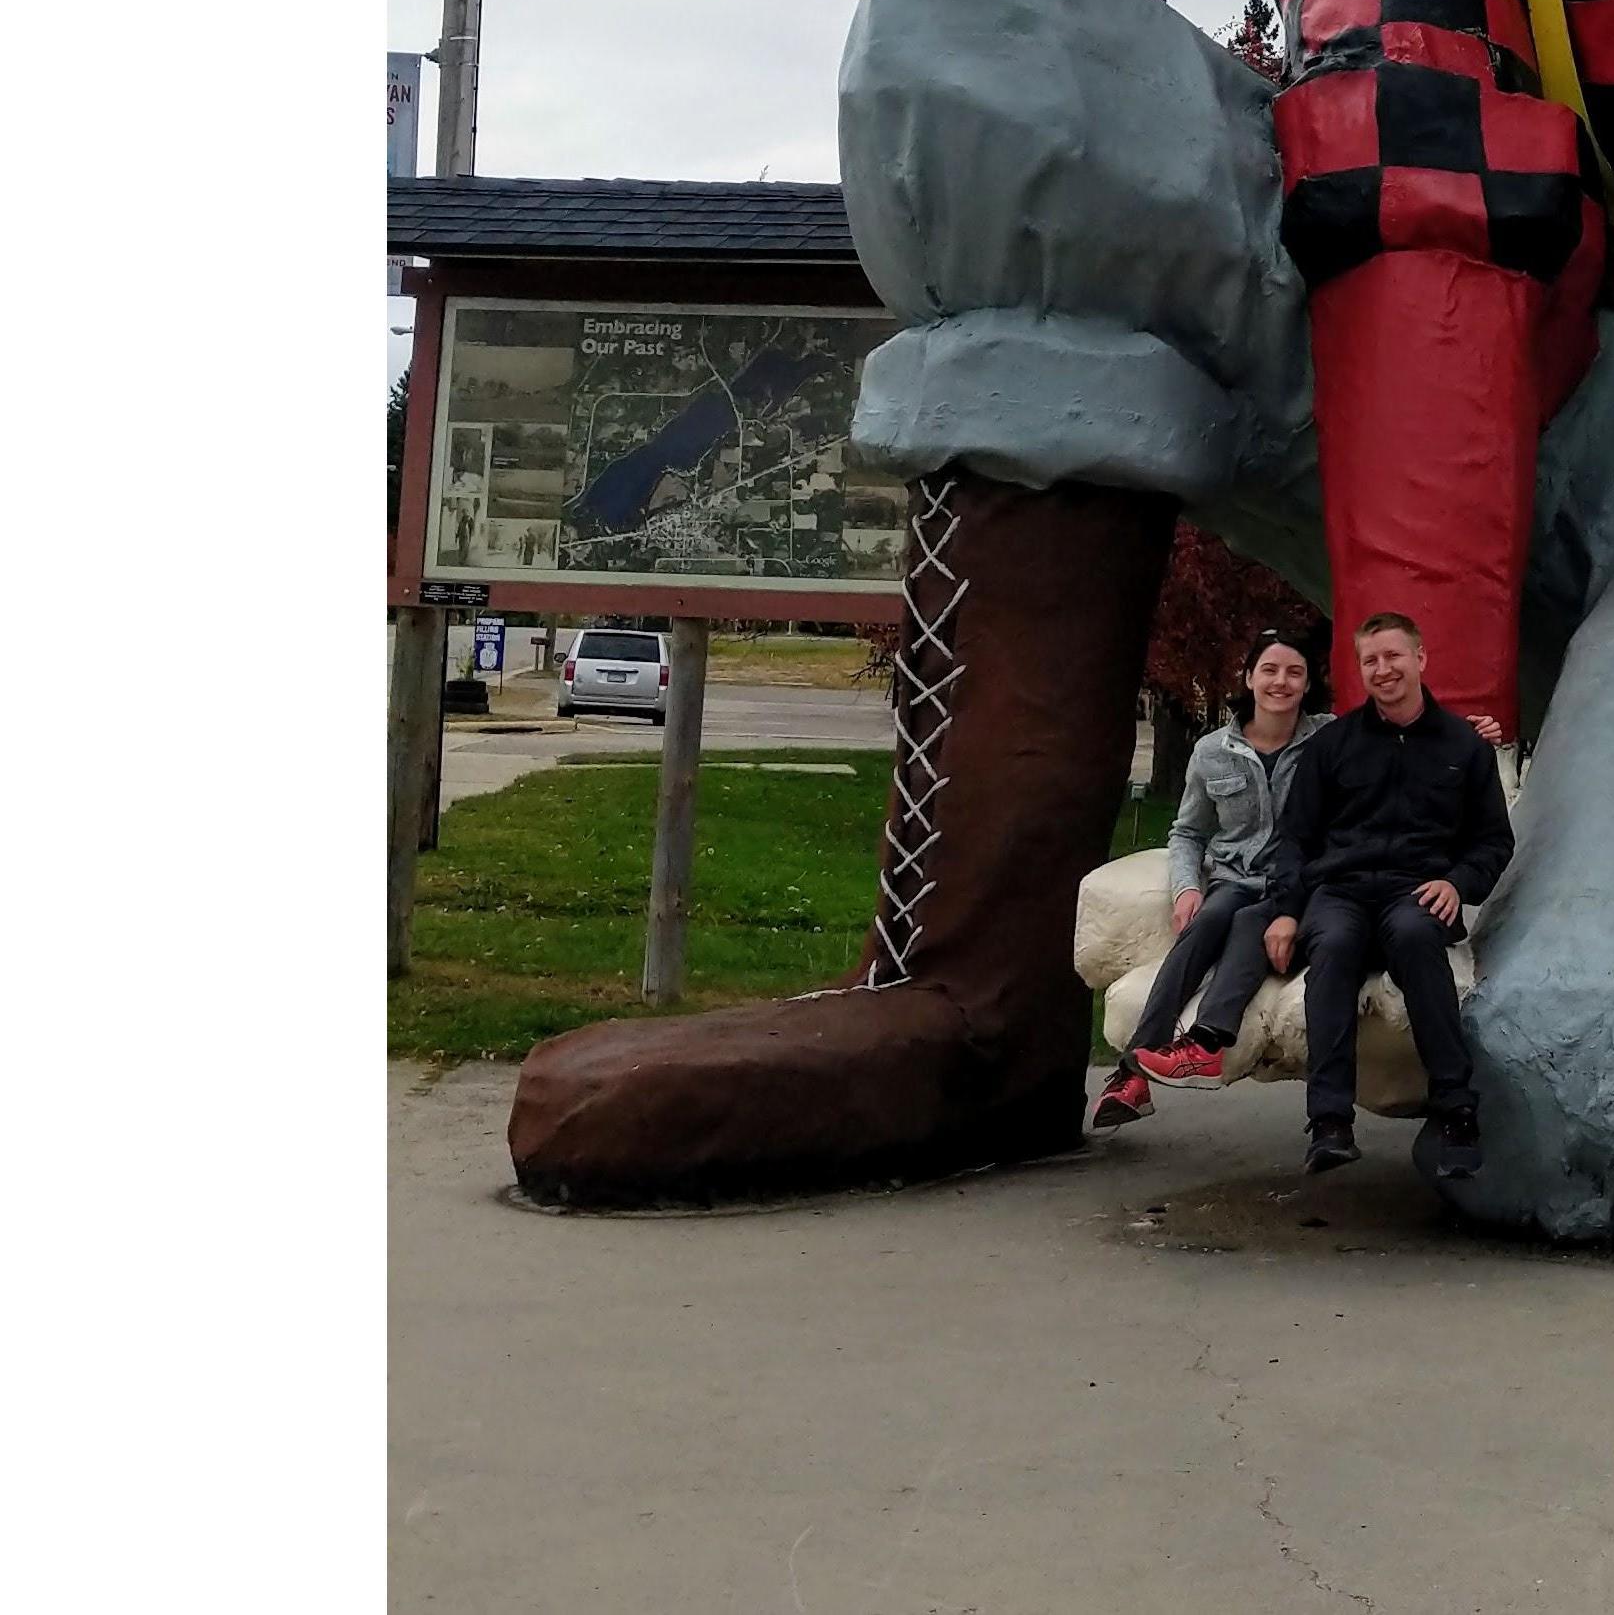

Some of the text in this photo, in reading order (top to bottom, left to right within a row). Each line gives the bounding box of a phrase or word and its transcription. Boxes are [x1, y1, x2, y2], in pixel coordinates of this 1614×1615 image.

[583, 318, 682, 340] Embracing
[581, 338, 664, 356] Our Past
